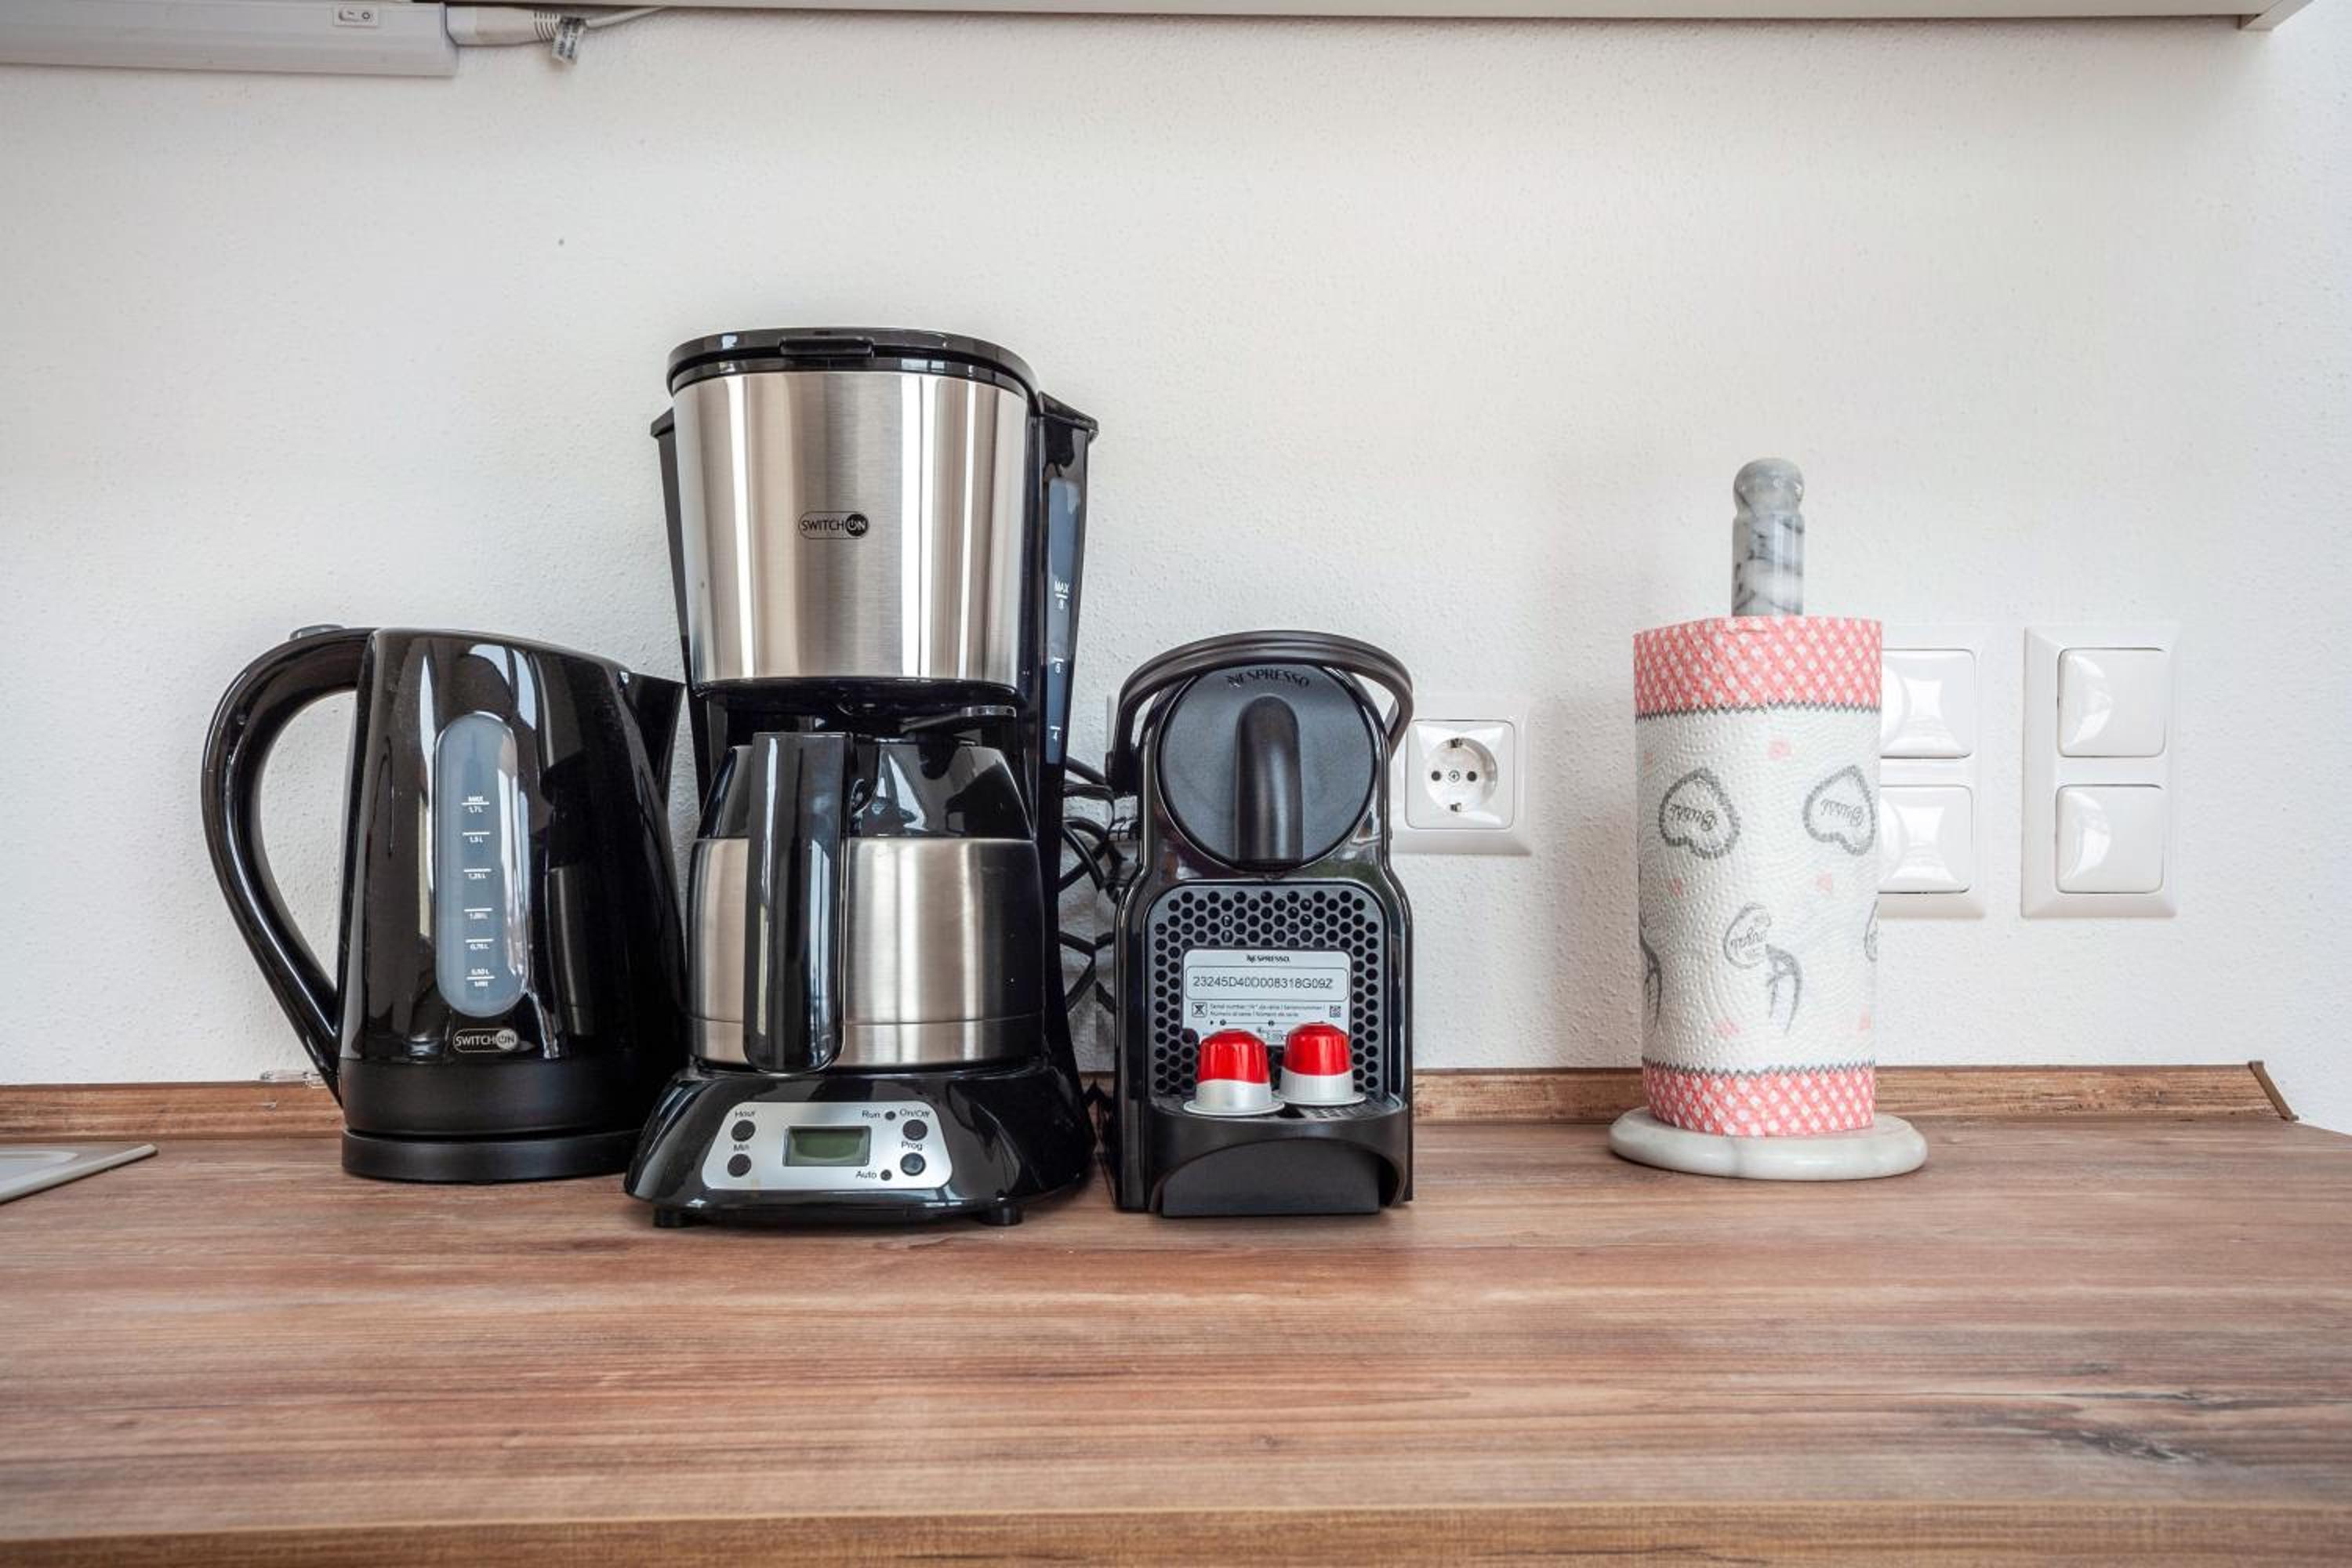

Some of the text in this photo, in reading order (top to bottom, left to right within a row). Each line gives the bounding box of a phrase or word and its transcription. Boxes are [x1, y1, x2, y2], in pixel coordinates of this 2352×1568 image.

[1054, 580, 1070, 593] MAX
[862, 1109, 880, 1119] Run
[901, 1142, 923, 1151] Prog
[855, 1170, 877, 1178] Auto
